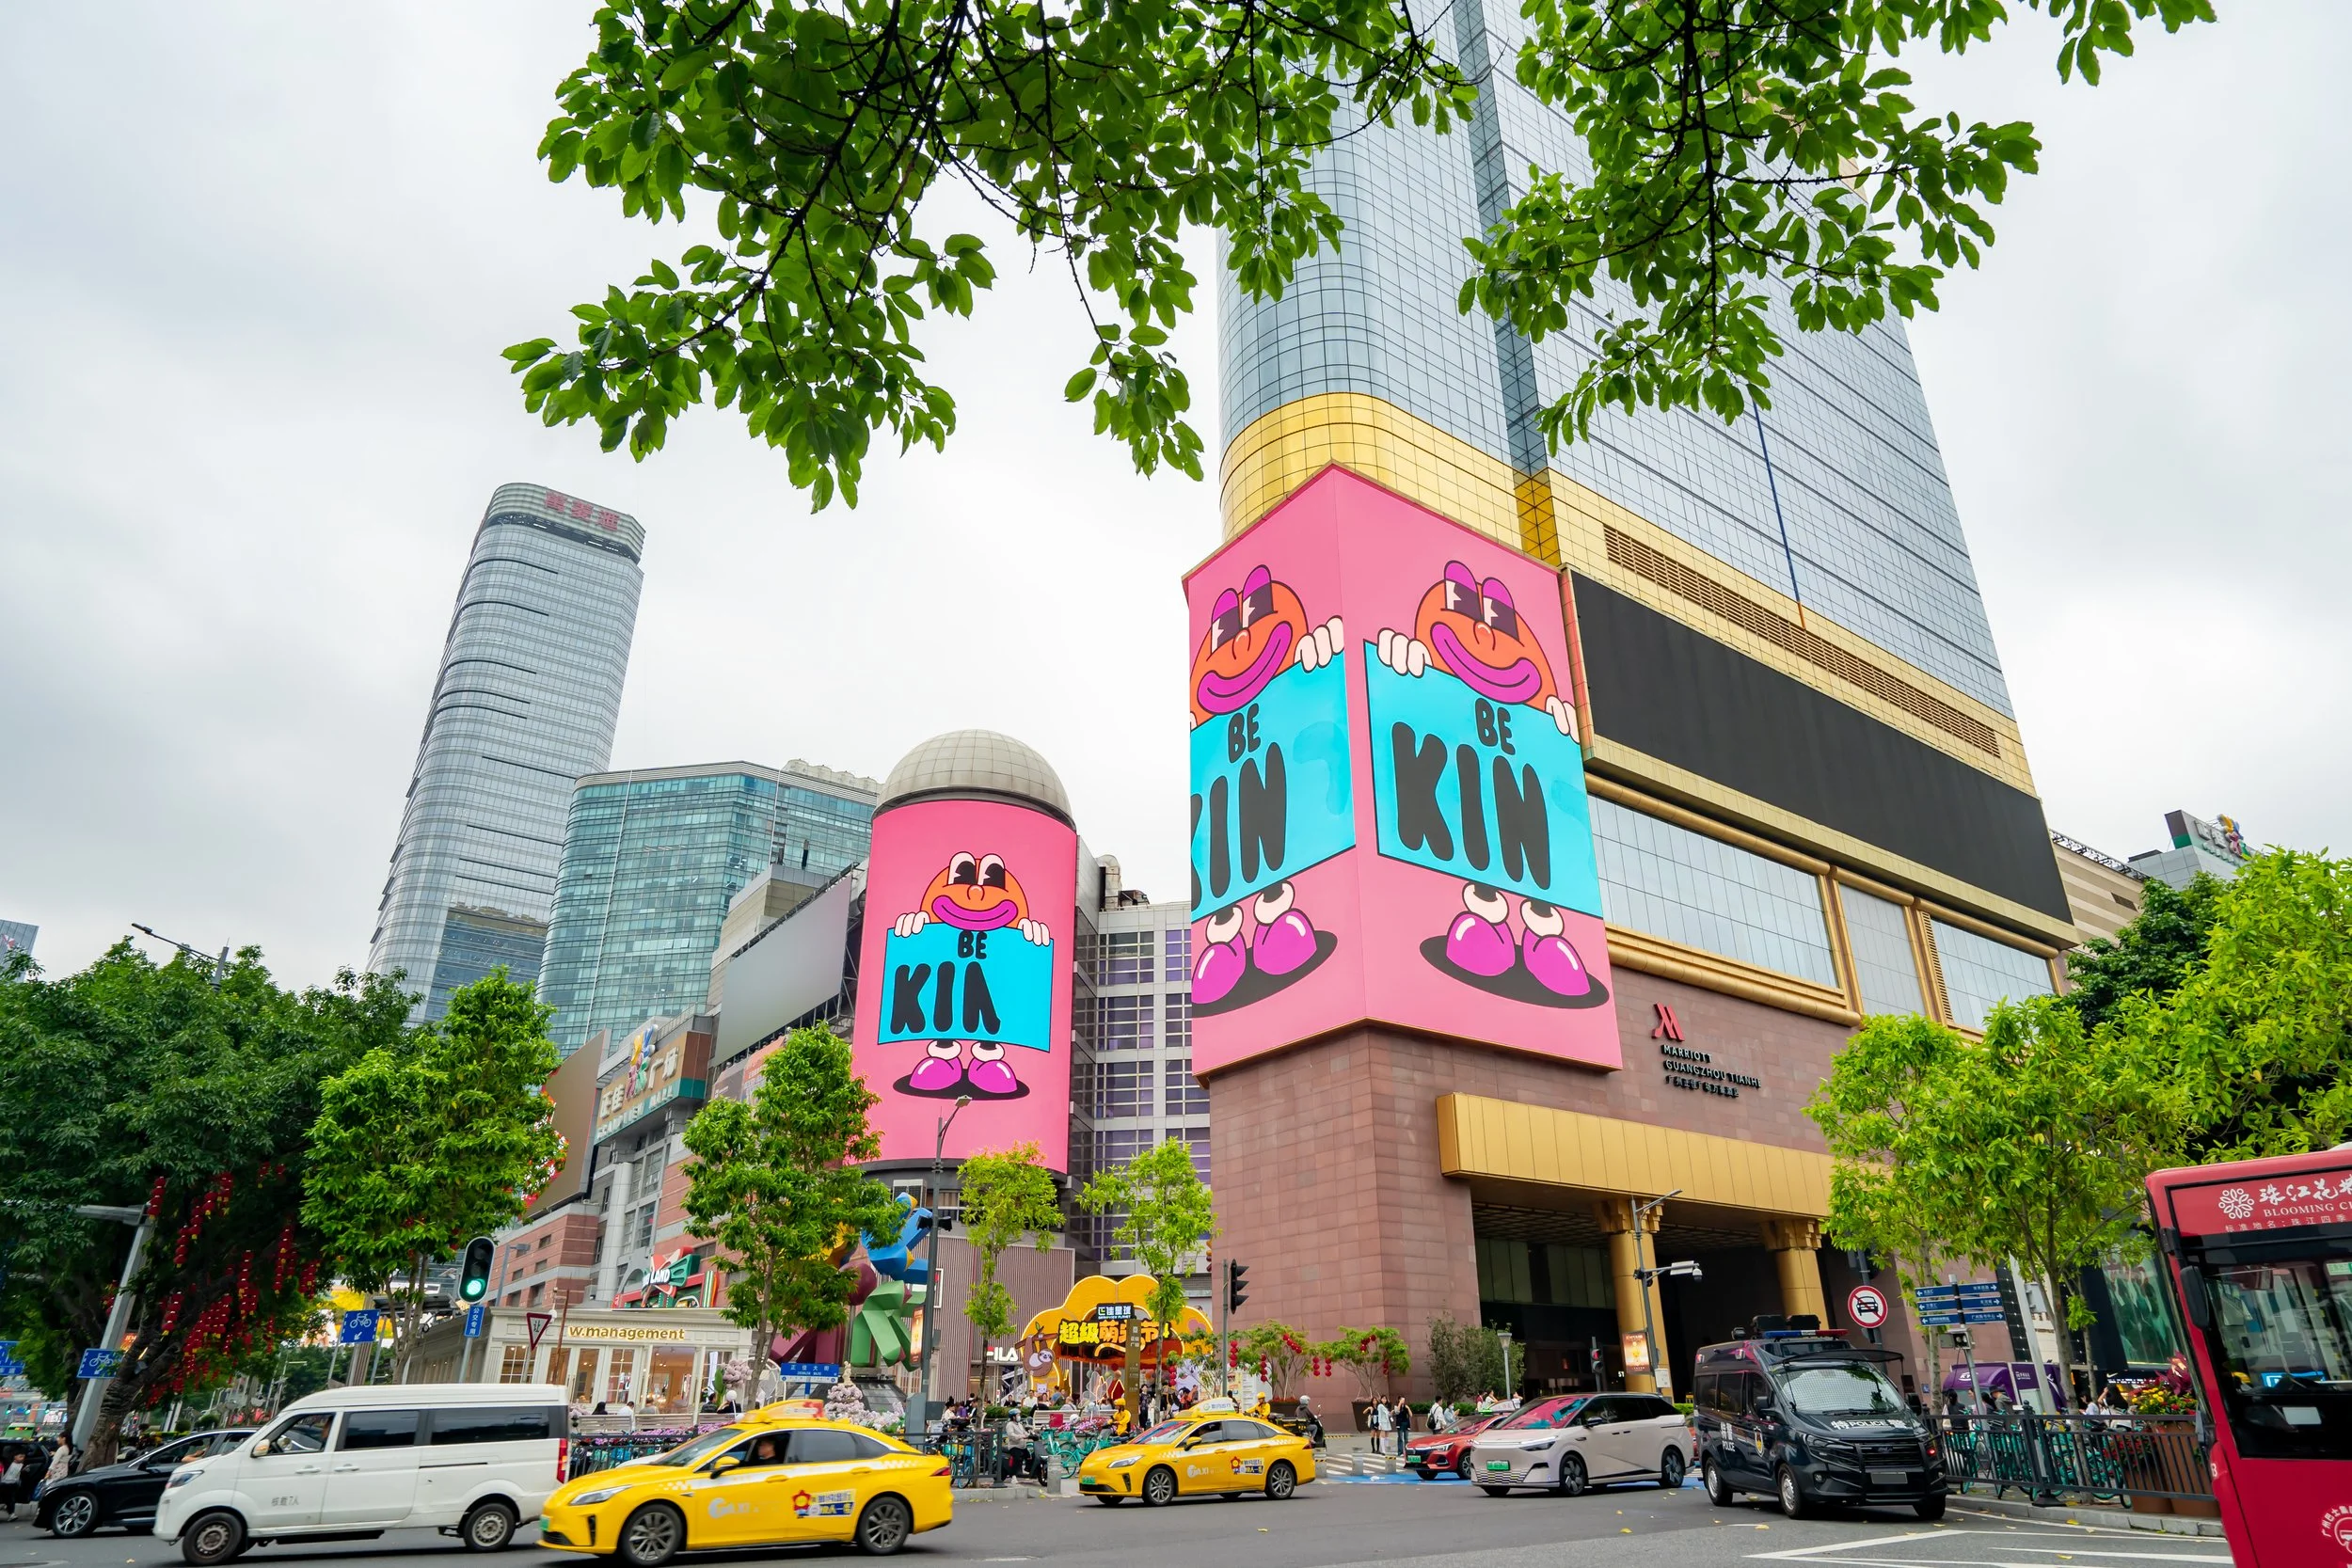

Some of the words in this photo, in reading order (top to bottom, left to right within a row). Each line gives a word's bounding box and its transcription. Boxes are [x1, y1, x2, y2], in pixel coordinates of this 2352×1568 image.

[1228, 704, 1260, 764] BE
[1474, 699, 1516, 755] BE
[1391, 721, 1551, 891] KIN
[957, 930, 988, 959] BE
[1662, 1044, 1712, 1063] MARRIOTT
[1664, 1059, 1726, 1081] GUANGZHOU
[2264, 1203, 2335, 1218] BLOOMING
[469, 1307, 480, 1335] 公交专用
[533, 1320, 541, 1333] 让
[569, 1327, 686, 1340] w.management
[1722, 1440, 1736, 1452] POLICE
